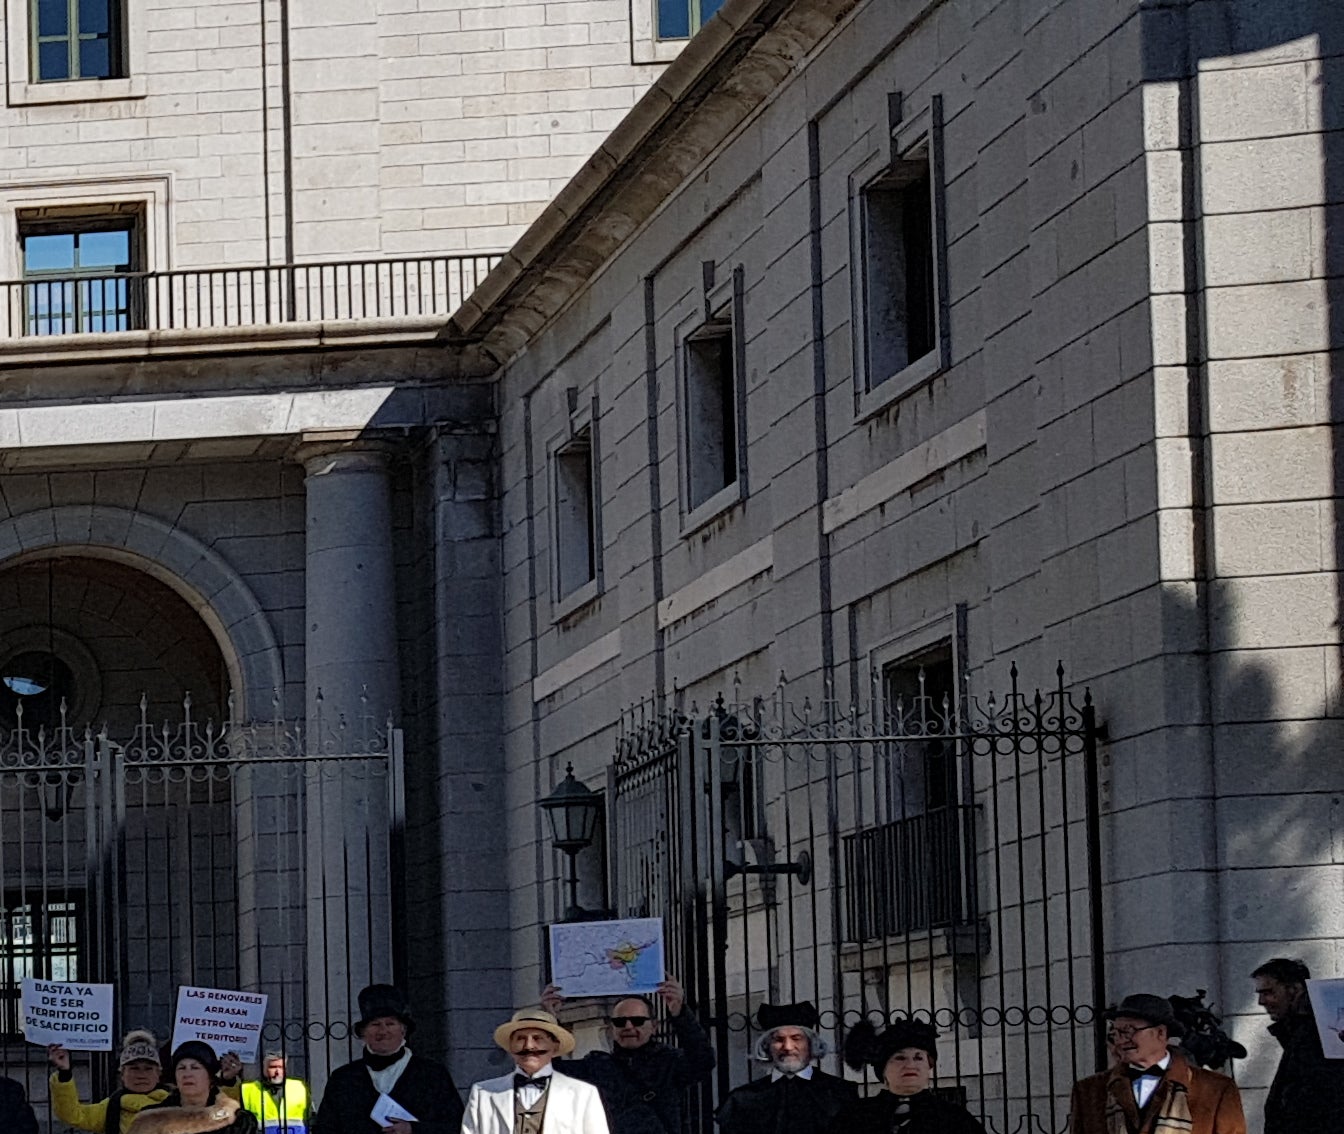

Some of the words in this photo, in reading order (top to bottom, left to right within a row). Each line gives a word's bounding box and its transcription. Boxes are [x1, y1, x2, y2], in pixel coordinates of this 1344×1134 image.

[35, 983, 73, 995] BASTA
[76, 987, 93, 996] YA
[42, 996, 57, 1006] DE
[60, 998, 84, 1008] SER
[187, 990, 205, 998] LAS
[208, 993, 262, 1004] RENOVABLES
[30, 1006, 100, 1020] TERRITORIO
[204, 1006, 248, 1016] ARRASAN
[25, 1016, 38, 1027] DE
[40, 1020, 108, 1033] SACRIFICIO
[180, 1017, 226, 1028] NUESTRO
[228, 1021, 260, 1031] VALIOSO
[195, 1032, 247, 1043] TERRITORIO
